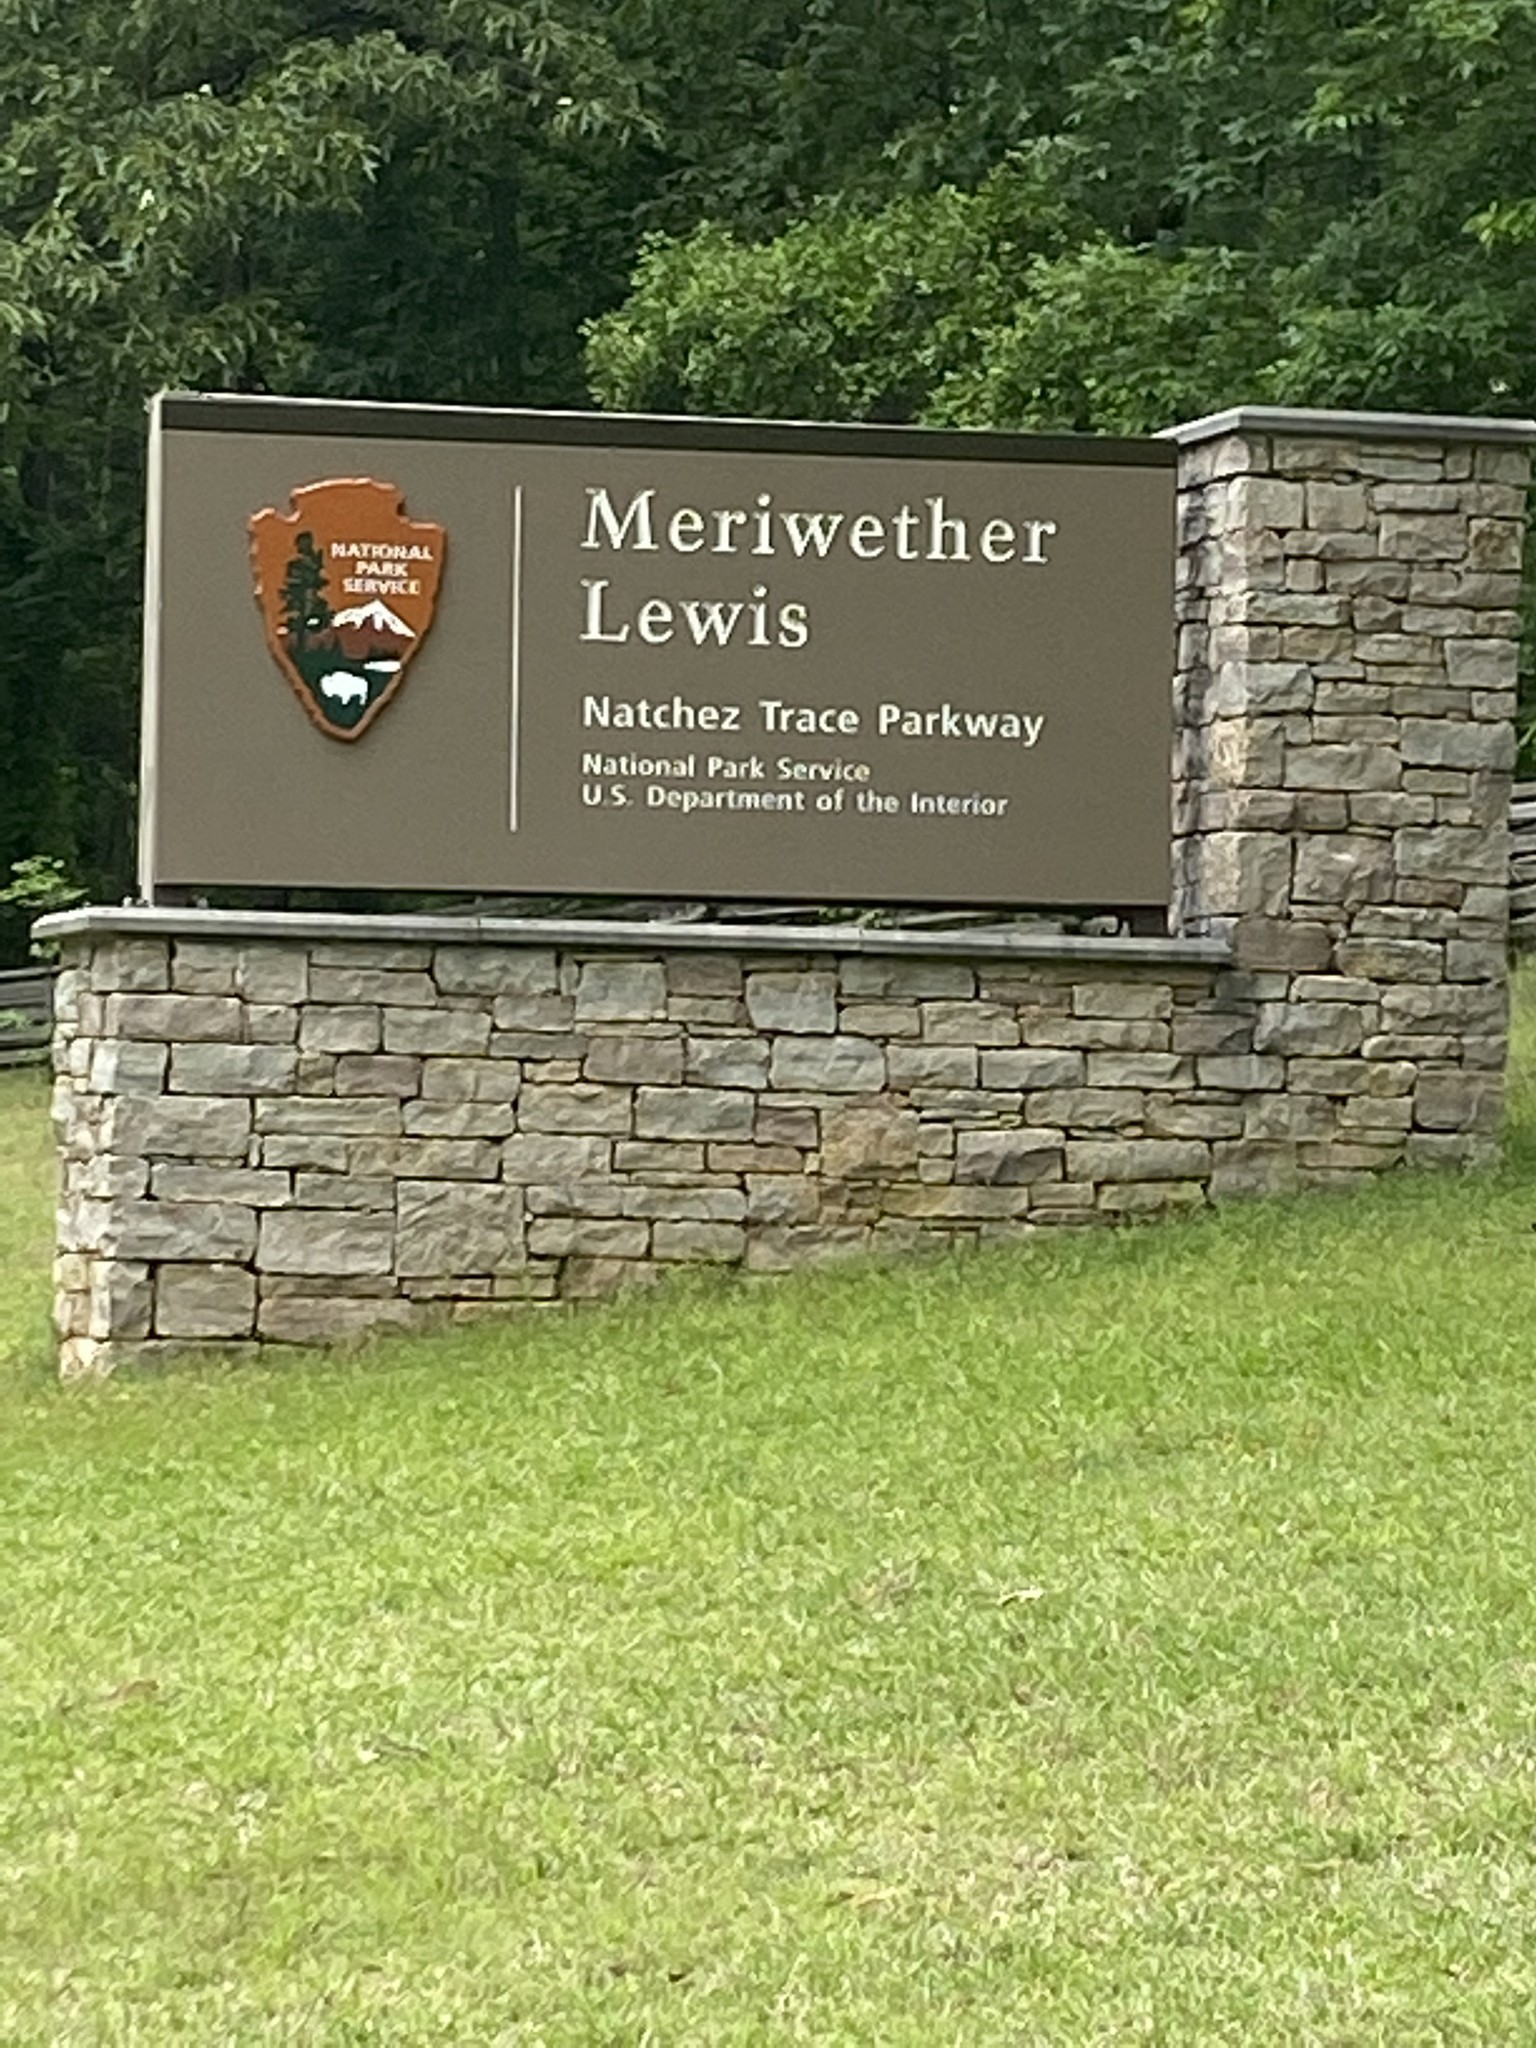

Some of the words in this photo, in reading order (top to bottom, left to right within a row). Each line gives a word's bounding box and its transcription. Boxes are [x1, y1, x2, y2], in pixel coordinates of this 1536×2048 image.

[580, 488, 1056, 564] Meriwether
[331, 542, 434, 561] NATIONAL
[354, 560, 409, 577] PARK
[342, 577, 421, 595] SERVICE
[580, 579, 808, 647] Lewis
[583, 696, 740, 730] Natchez
[759, 700, 860, 733] Trace
[879, 703, 1044, 747] Parkway
[582, 753, 695, 778] National
[708, 756, 765, 778] Park
[777, 757, 870, 782] Service
[582, 783, 633, 807] U.S.
[647, 785, 805, 813] Department
[816, 788, 844, 811] of
[856, 789, 899, 813] the
[911, 792, 1008, 815] Interior
